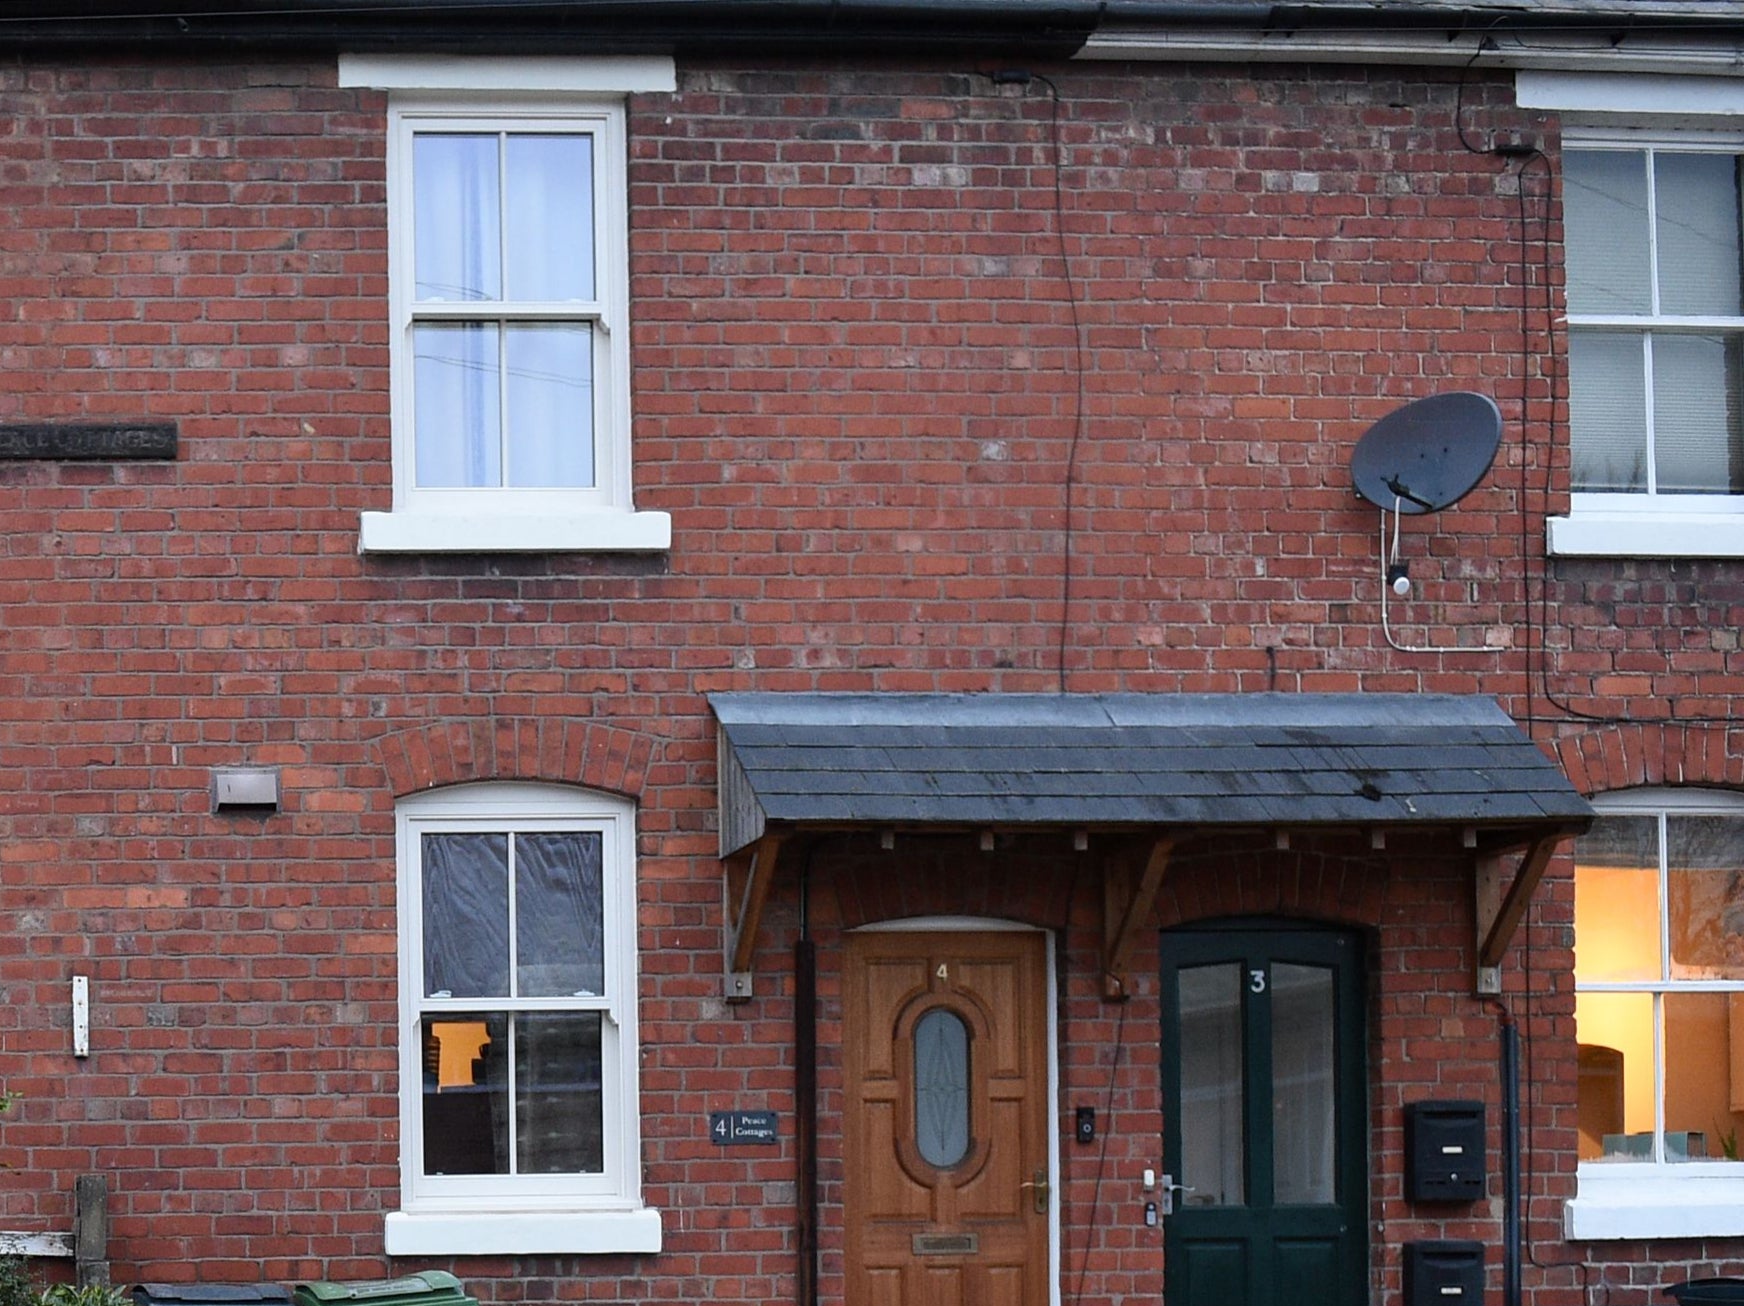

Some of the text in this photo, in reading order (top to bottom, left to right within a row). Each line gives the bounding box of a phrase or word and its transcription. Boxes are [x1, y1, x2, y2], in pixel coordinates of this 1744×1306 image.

[936, 963, 948, 982] 4
[1250, 970, 1266, 993] 3
[715, 1118, 727, 1137] 4
[736, 1127, 773, 1138] Cottages
